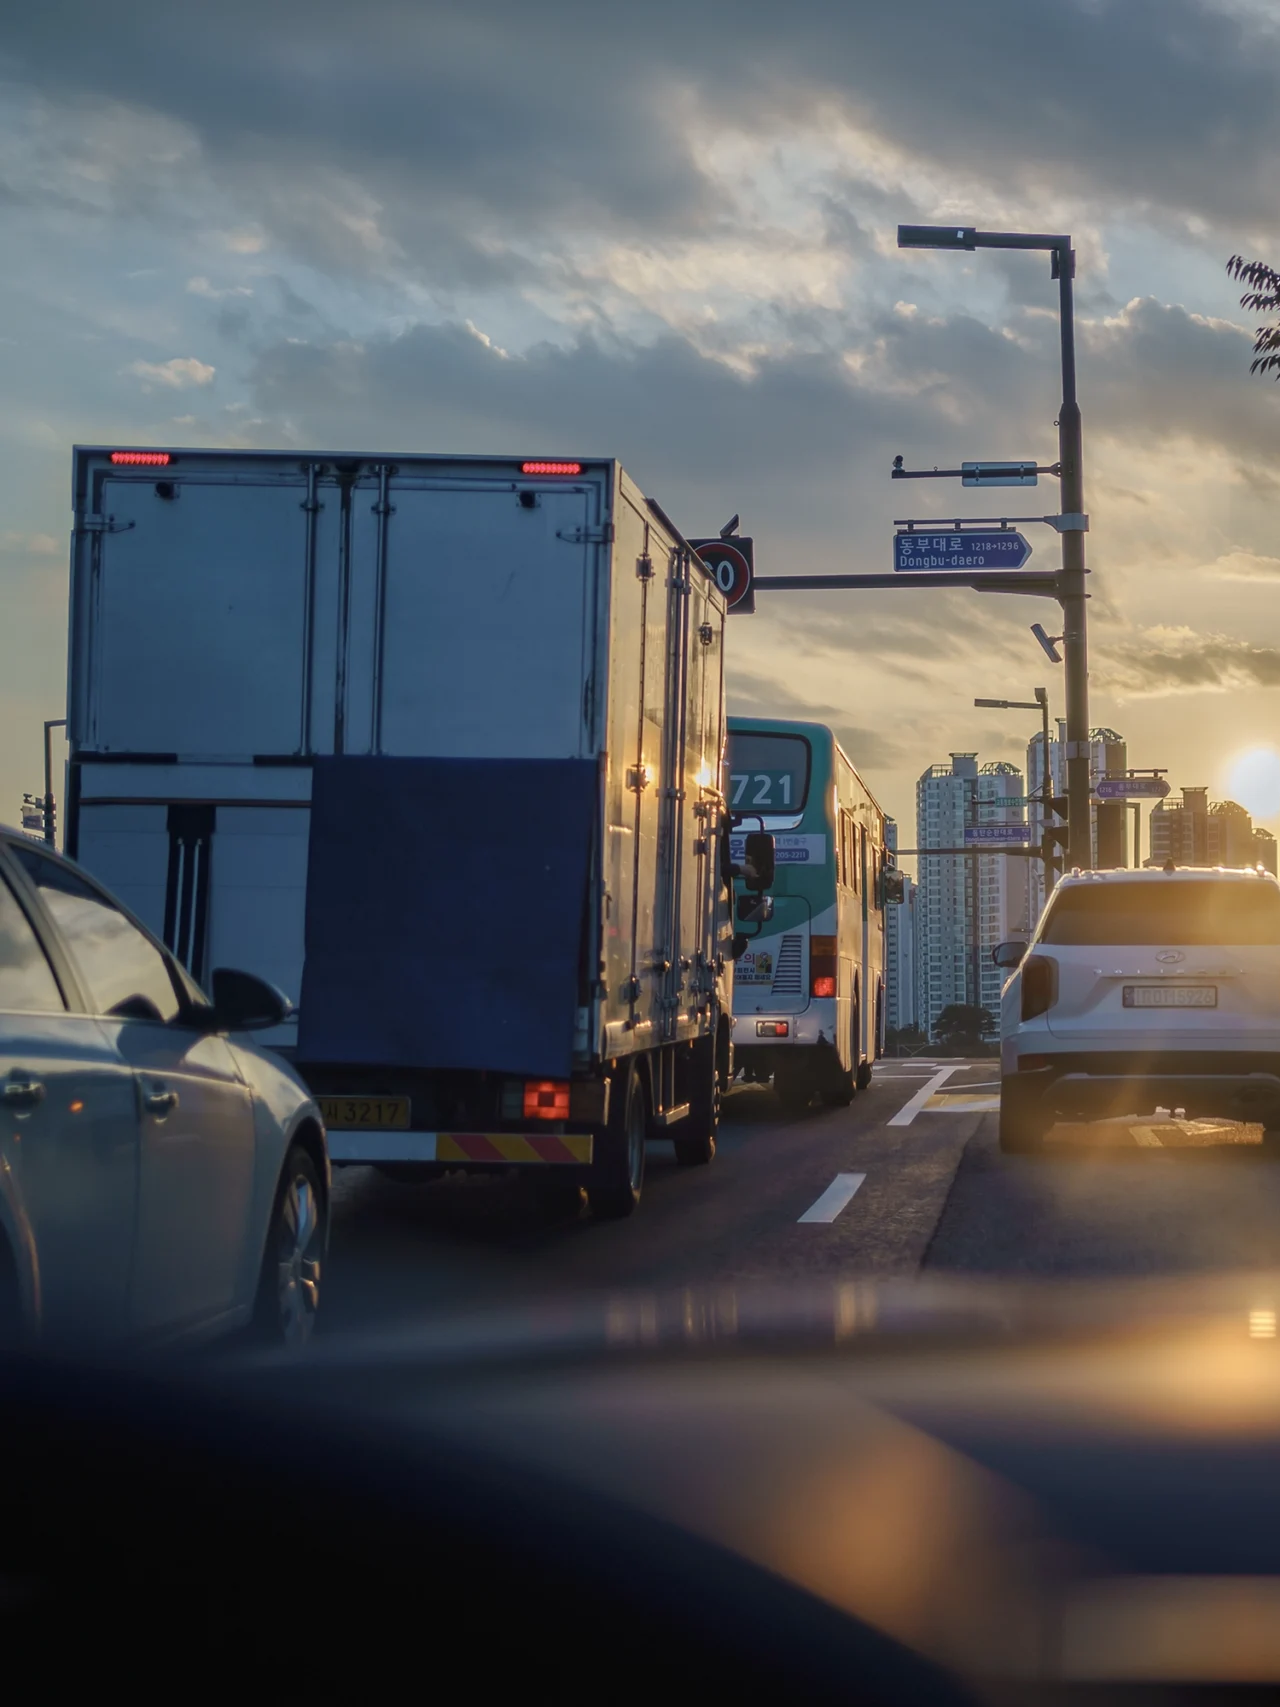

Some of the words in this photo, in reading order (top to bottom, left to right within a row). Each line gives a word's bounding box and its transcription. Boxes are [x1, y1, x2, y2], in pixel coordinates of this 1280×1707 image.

[900, 538, 963, 554] 동부대로
[971, 542, 991, 551] 1218
[997, 541, 1019, 550] 1296
[900, 555, 985, 568] Dongbu-daero
[704, 560, 734, 592] 0
[730, 775, 790, 804] 721
[344, 1101, 400, 1124] 3217
